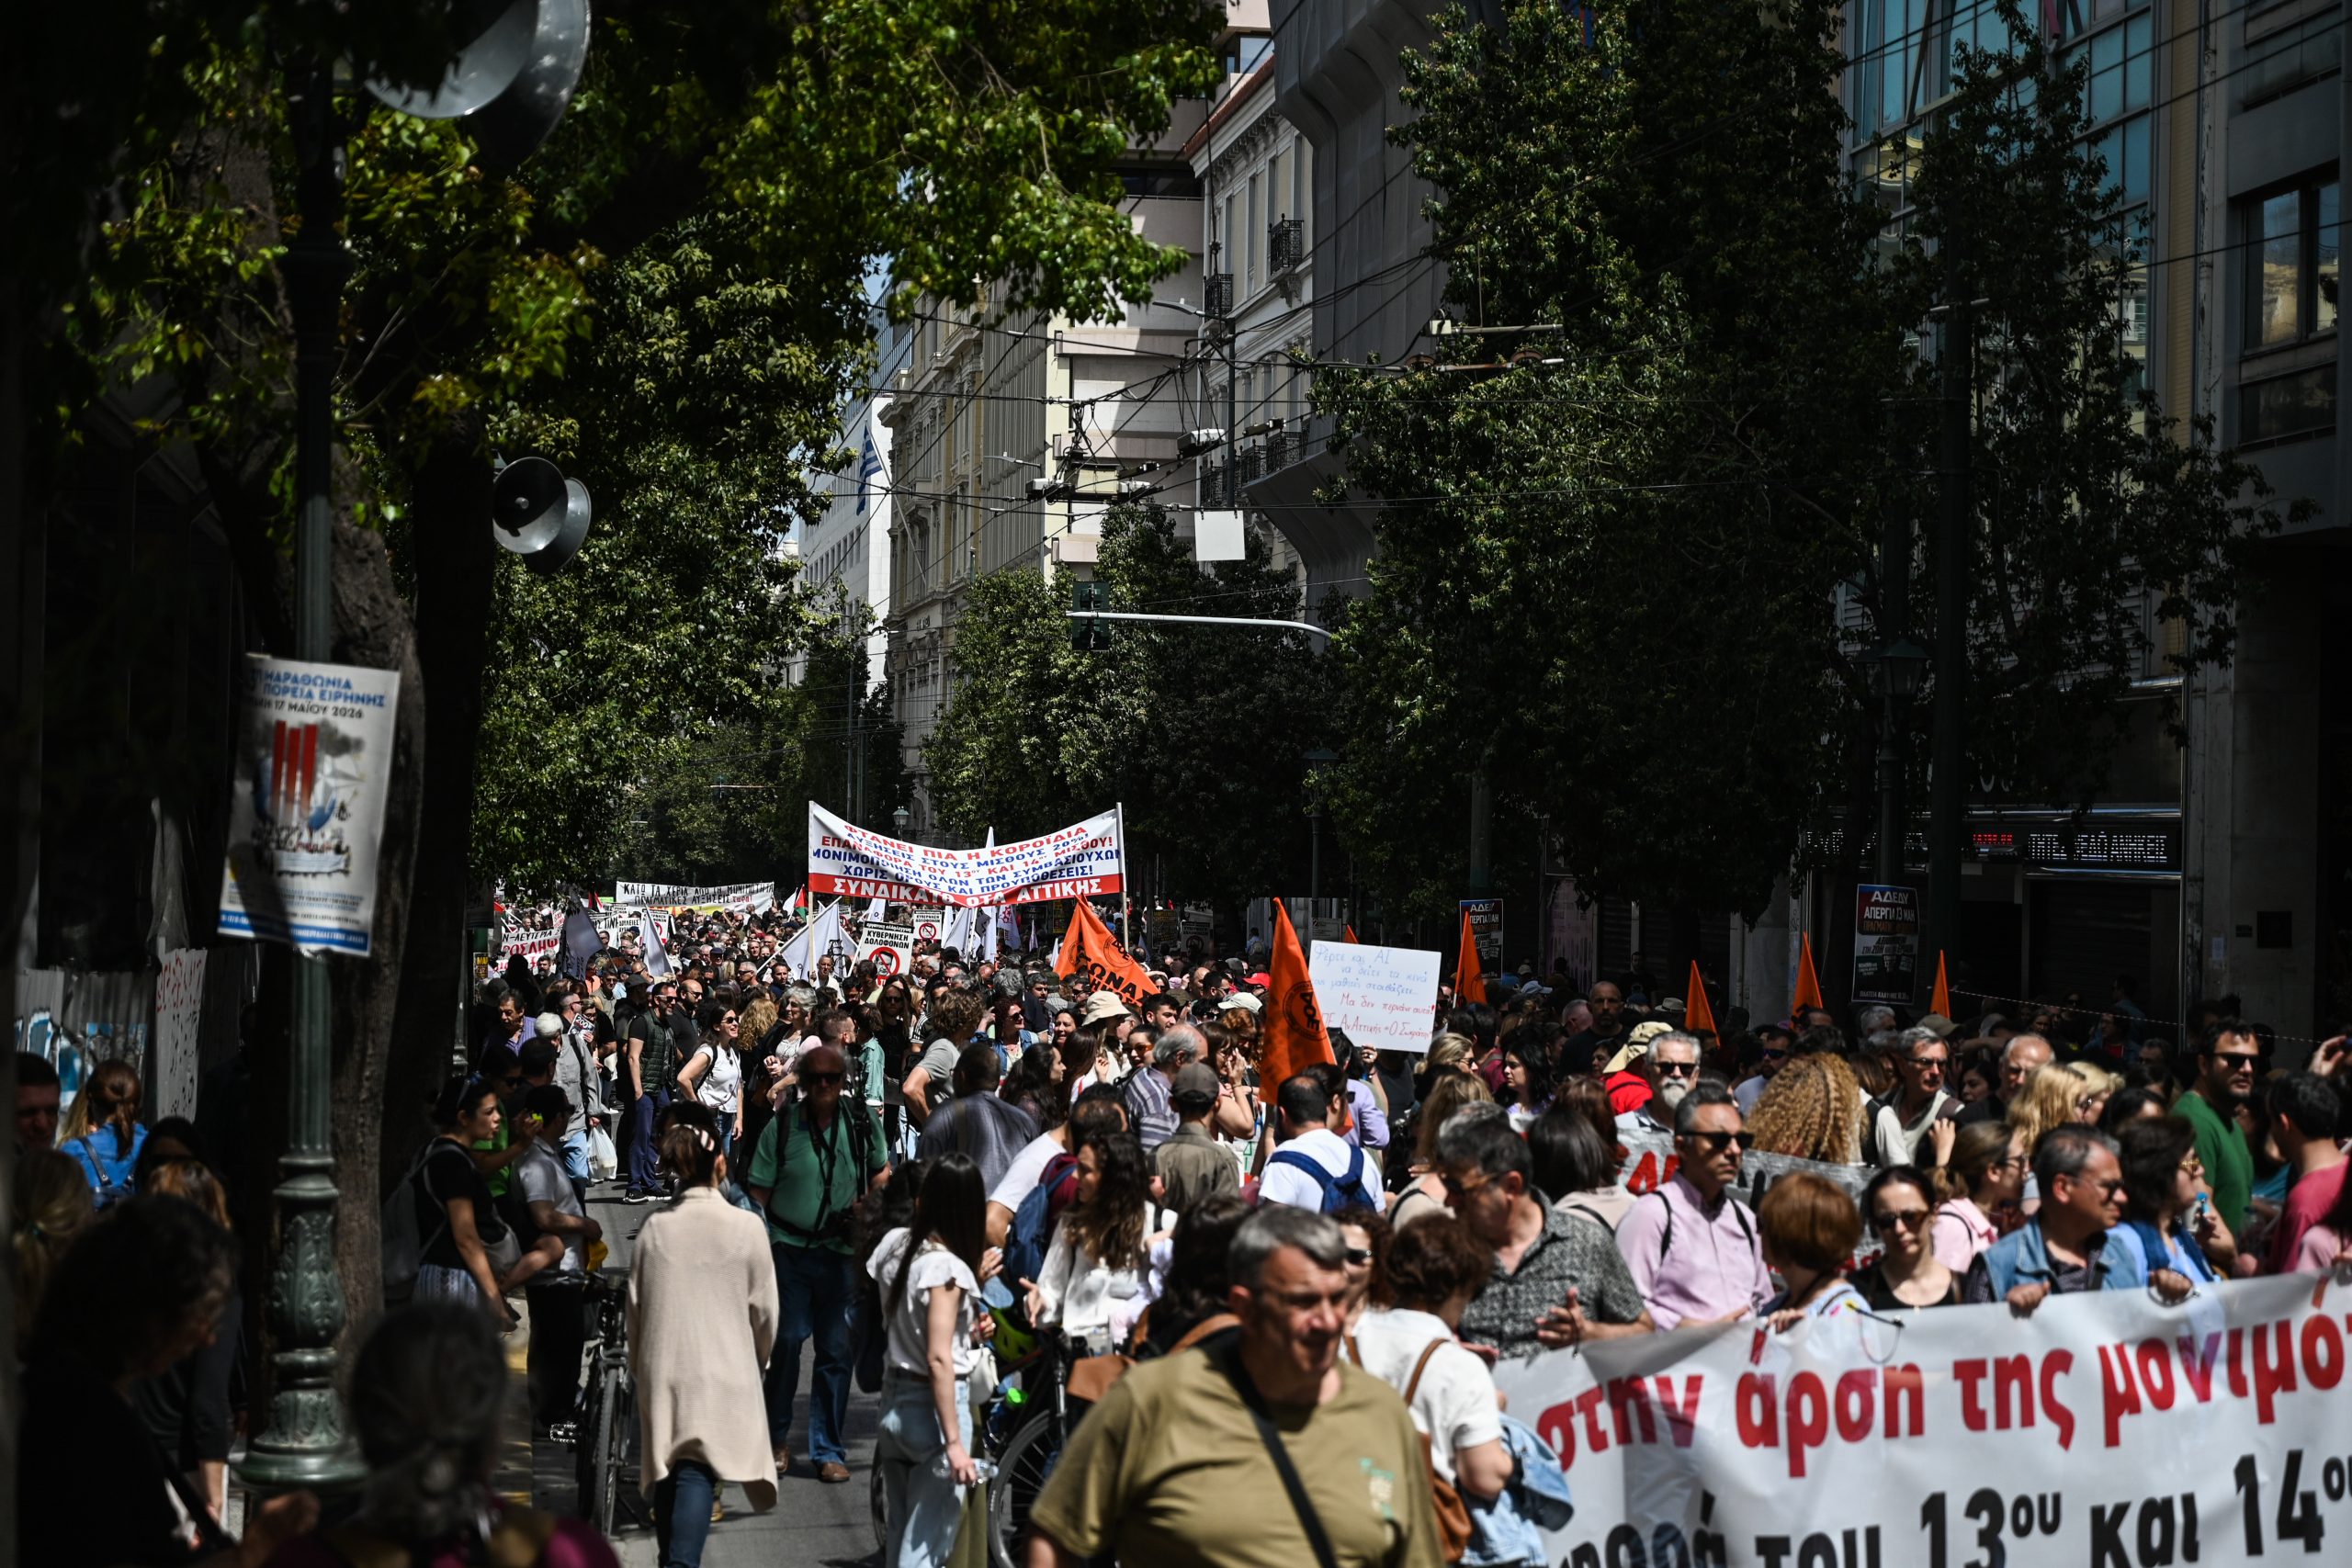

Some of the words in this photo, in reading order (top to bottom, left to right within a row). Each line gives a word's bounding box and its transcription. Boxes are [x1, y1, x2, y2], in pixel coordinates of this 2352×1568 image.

[265, 671, 352, 690] ΜΑΡΑΘΩΝΙΑ
[264, 683, 315, 701] ΠΟΡΕΙΑ
[319, 691, 386, 707] ΕΙΡΗΝΗΣ
[332, 706, 364, 718] 2026
[844, 825, 914, 854] ΦΤΑΝΕΙ
[923, 849, 957, 862] ΠΙΑ
[967, 852, 980, 862] Η
[990, 827, 1088, 859] ΚΟΡΟΪΔΙΑ
[847, 832, 915, 863] ΑΥΞΗΣΕΙΣ
[922, 858, 969, 871] ΣΤΟΥΣ
[977, 848, 1046, 869] ΜΙΣΘΟΥΣ
[821, 835, 913, 869] ΕΠΑΝΑΦΟΡΑ
[921, 864, 946, 876] ΤΟΥ
[988, 863, 1015, 875] ΚΑΙ
[843, 864, 888, 881] ΧΩΡΙΣ
[948, 884, 973, 896] ΚΑΙ
[928, 874, 969, 887] ΟΛΩΝ
[976, 874, 1007, 885] ΤΩΝ
[624, 884, 646, 895] ΚΑΤΩ
[833, 877, 955, 905] ΣΥΝΔΙΚΑΤΟ
[966, 890, 1007, 908] ΟΤΑ
[1016, 877, 1102, 903] ΑΤΤΙΚΗΣ
[1871, 890, 1908, 905] ΑΔΕΔΥ
[692, 894, 730, 905] ΑΥΞΗΣΕΙΣ
[1470, 915, 1488, 925] ΠΕΡΓΙΑ
[1863, 906, 1895, 920] ΑΠΕΡΓΙΑ
[865, 938, 910, 949] ΔΟΛΟΦΟΝΩΝ
[867, 930, 909, 942] ΚΥΒΕΡΝΗΣΗ
[1340, 993, 1356, 1008] Μα
[1361, 995, 1375, 1008] δεν
[1300, 992, 1319, 1031] ΔΟΕ
[1537, 1374, 1703, 1472] στην
[1736, 1327, 1925, 1478] άρση
[1952, 1348, 2075, 1451] της
[2097, 1274, 2352, 1449] μονιμό
[2089, 1491, 2199, 1568] και
